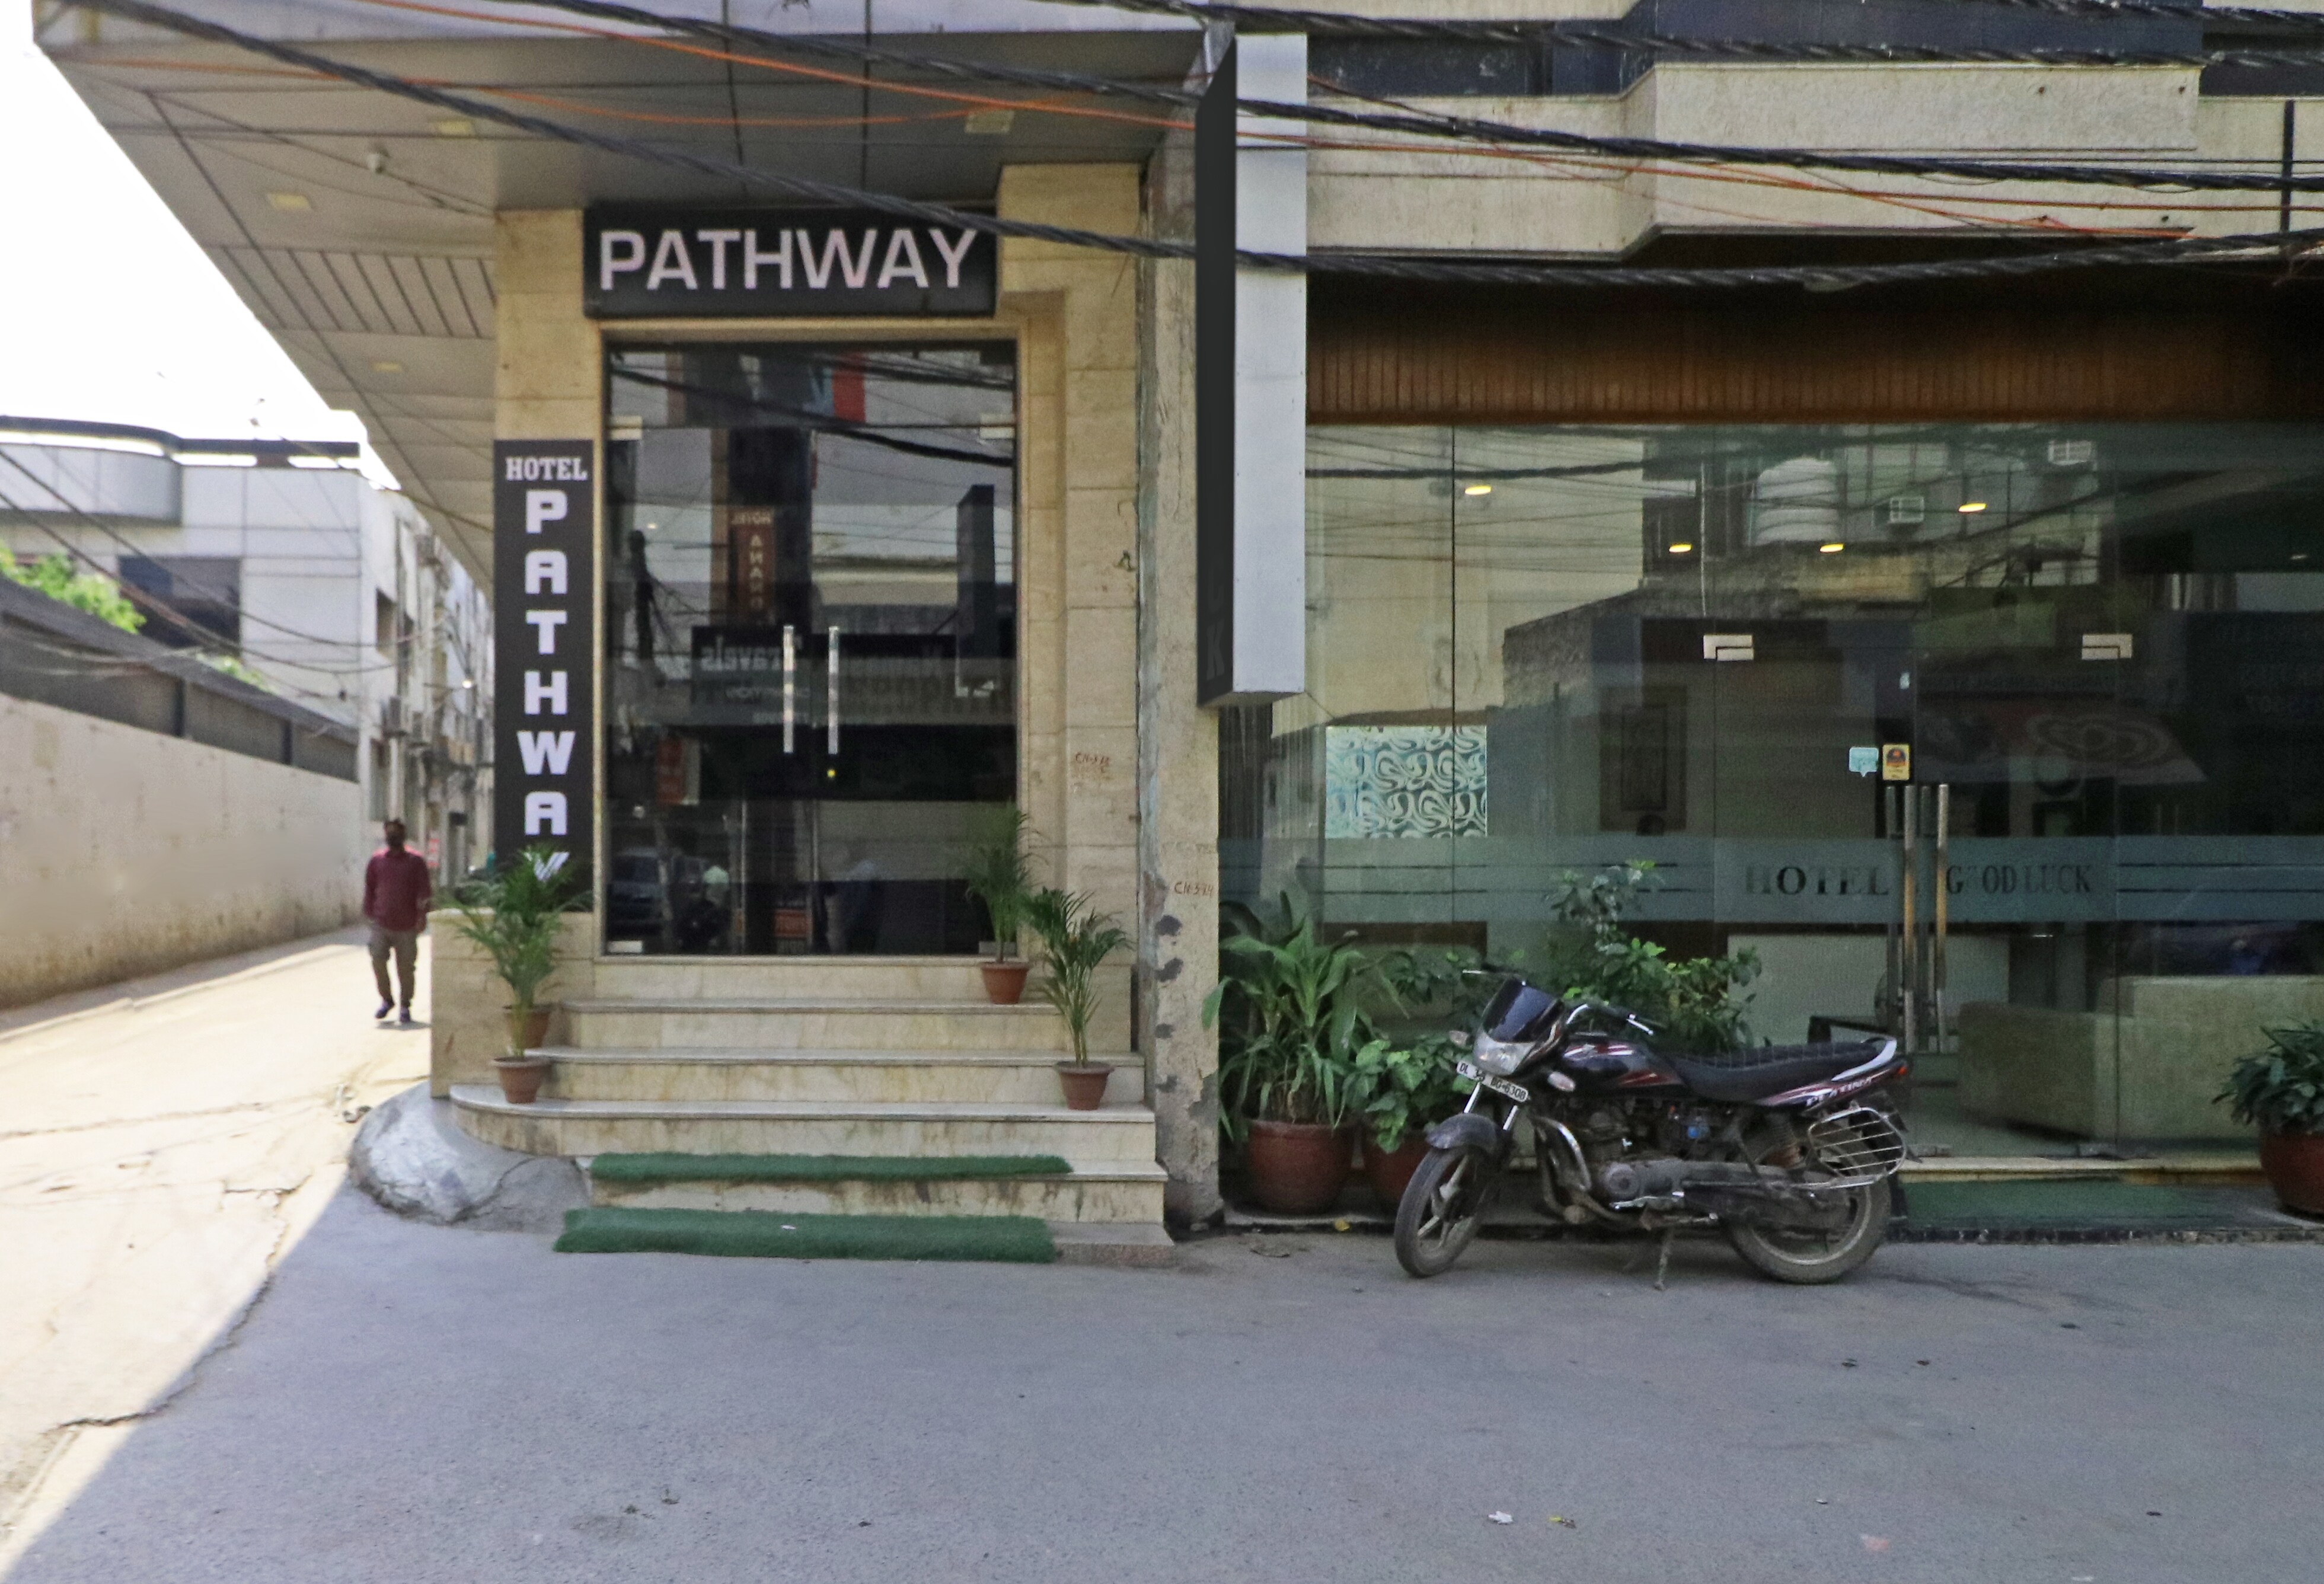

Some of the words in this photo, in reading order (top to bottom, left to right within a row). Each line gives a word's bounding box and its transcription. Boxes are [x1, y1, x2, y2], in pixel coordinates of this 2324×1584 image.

[599, 228, 977, 291] PATHWAY
[505, 456, 588, 482] HOTEL
[1745, 866, 1889, 896] HOTEL
[1946, 864, 2017, 895] GOD
[2028, 864, 2091, 894] LUCK
